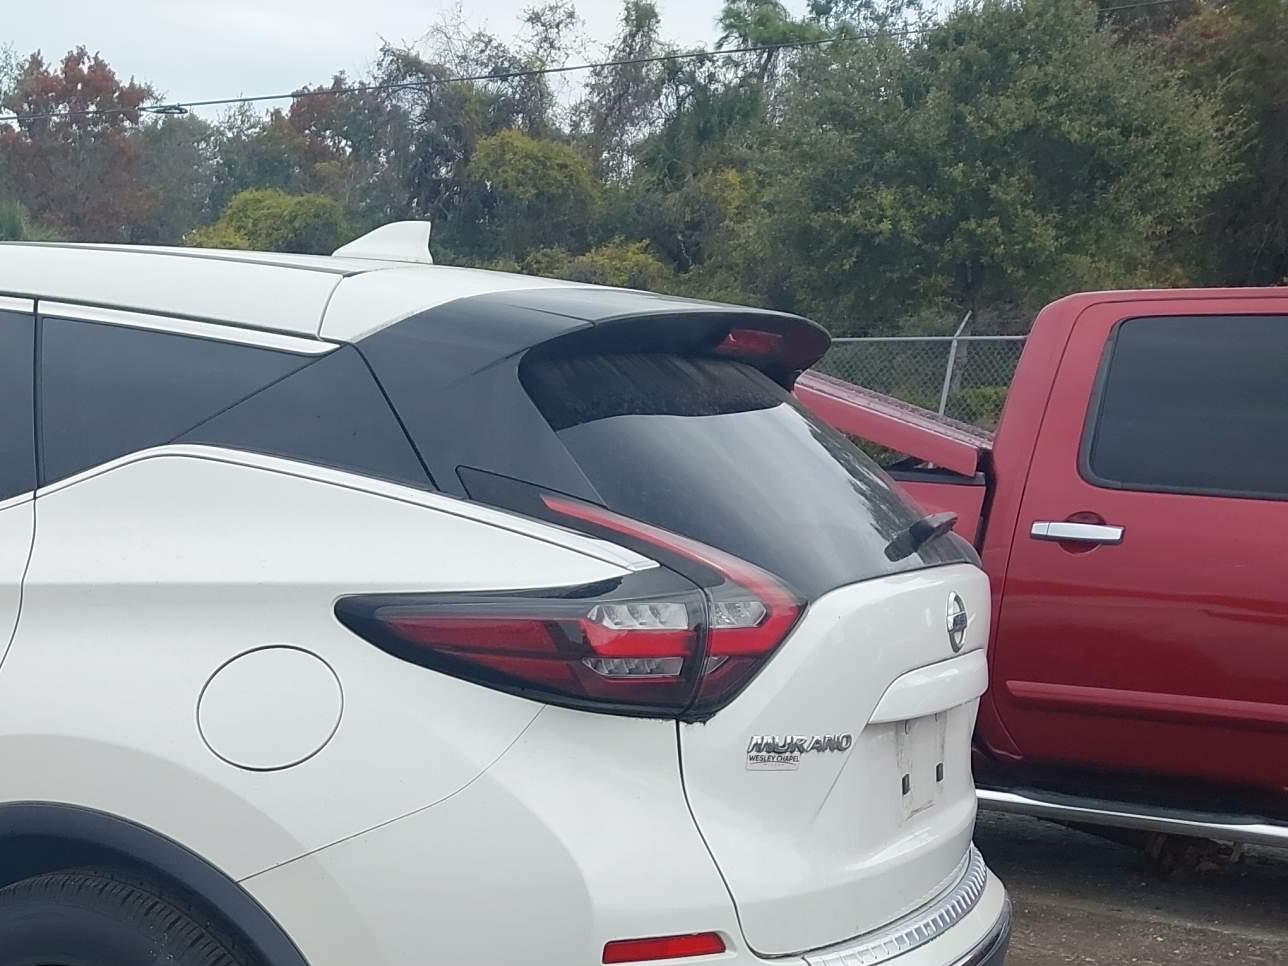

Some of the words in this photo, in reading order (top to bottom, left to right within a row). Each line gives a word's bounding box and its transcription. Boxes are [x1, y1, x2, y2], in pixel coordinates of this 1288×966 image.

[747, 733, 853, 754] MURANO
[748, 754, 775, 762] WESLEY
[776, 754, 800, 763] CHAPEL
